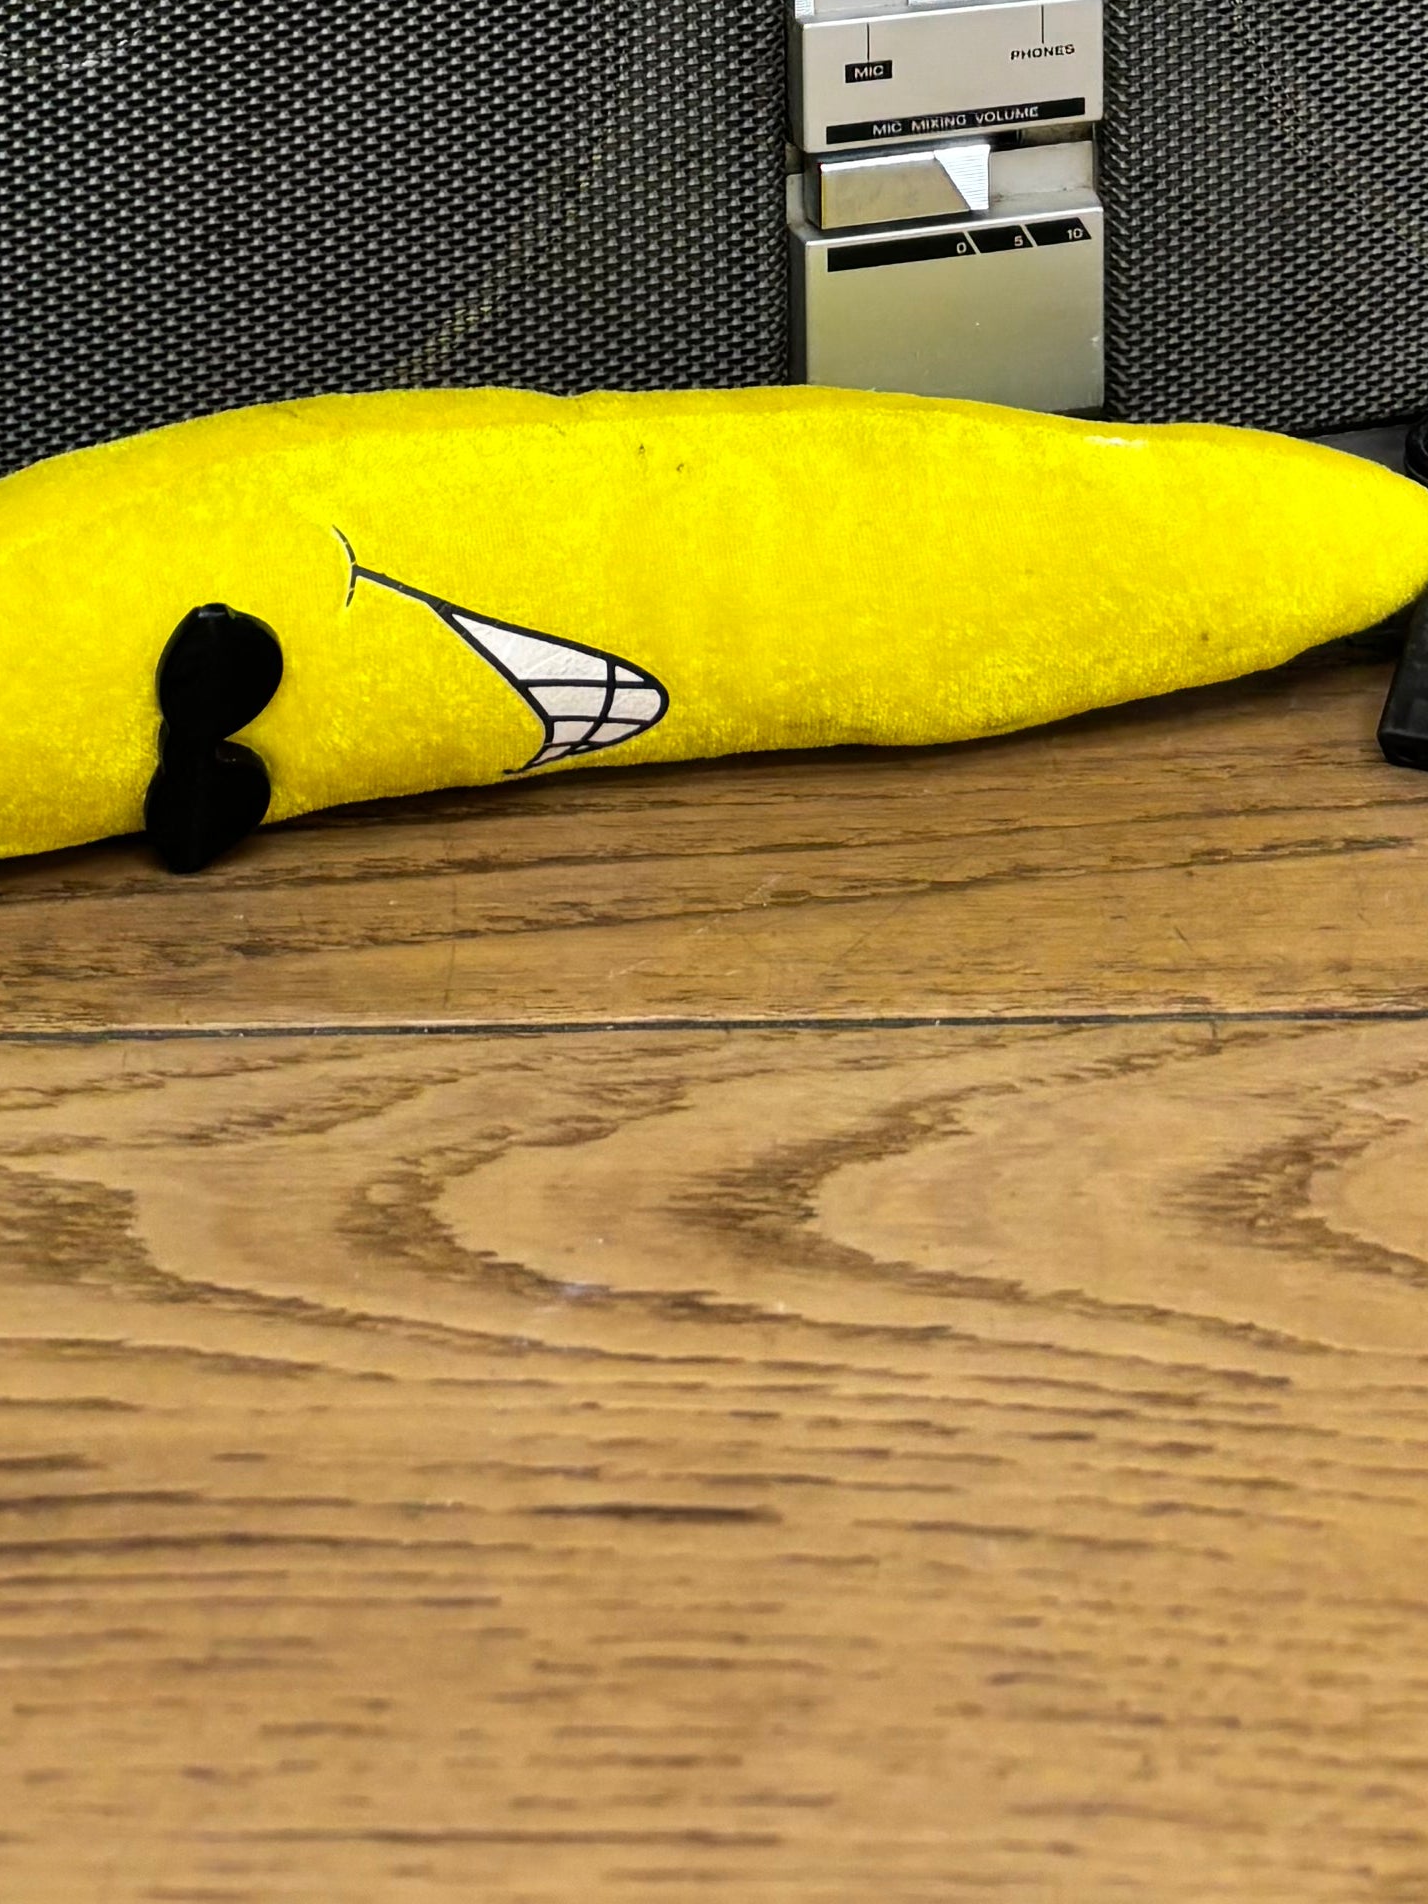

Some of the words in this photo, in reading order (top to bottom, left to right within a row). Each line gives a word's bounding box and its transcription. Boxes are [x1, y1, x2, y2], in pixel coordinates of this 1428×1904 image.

[1011, 44, 1075, 61] PHONES
[854, 65, 884, 79] MIC
[873, 121, 902, 136] MIC
[912, 114, 967, 131] MIXING
[976, 106, 1039, 124] VOLUME
[957, 242, 966, 254] 0
[1014, 235, 1023, 247] 5
[1067, 228, 1083, 240] 10
